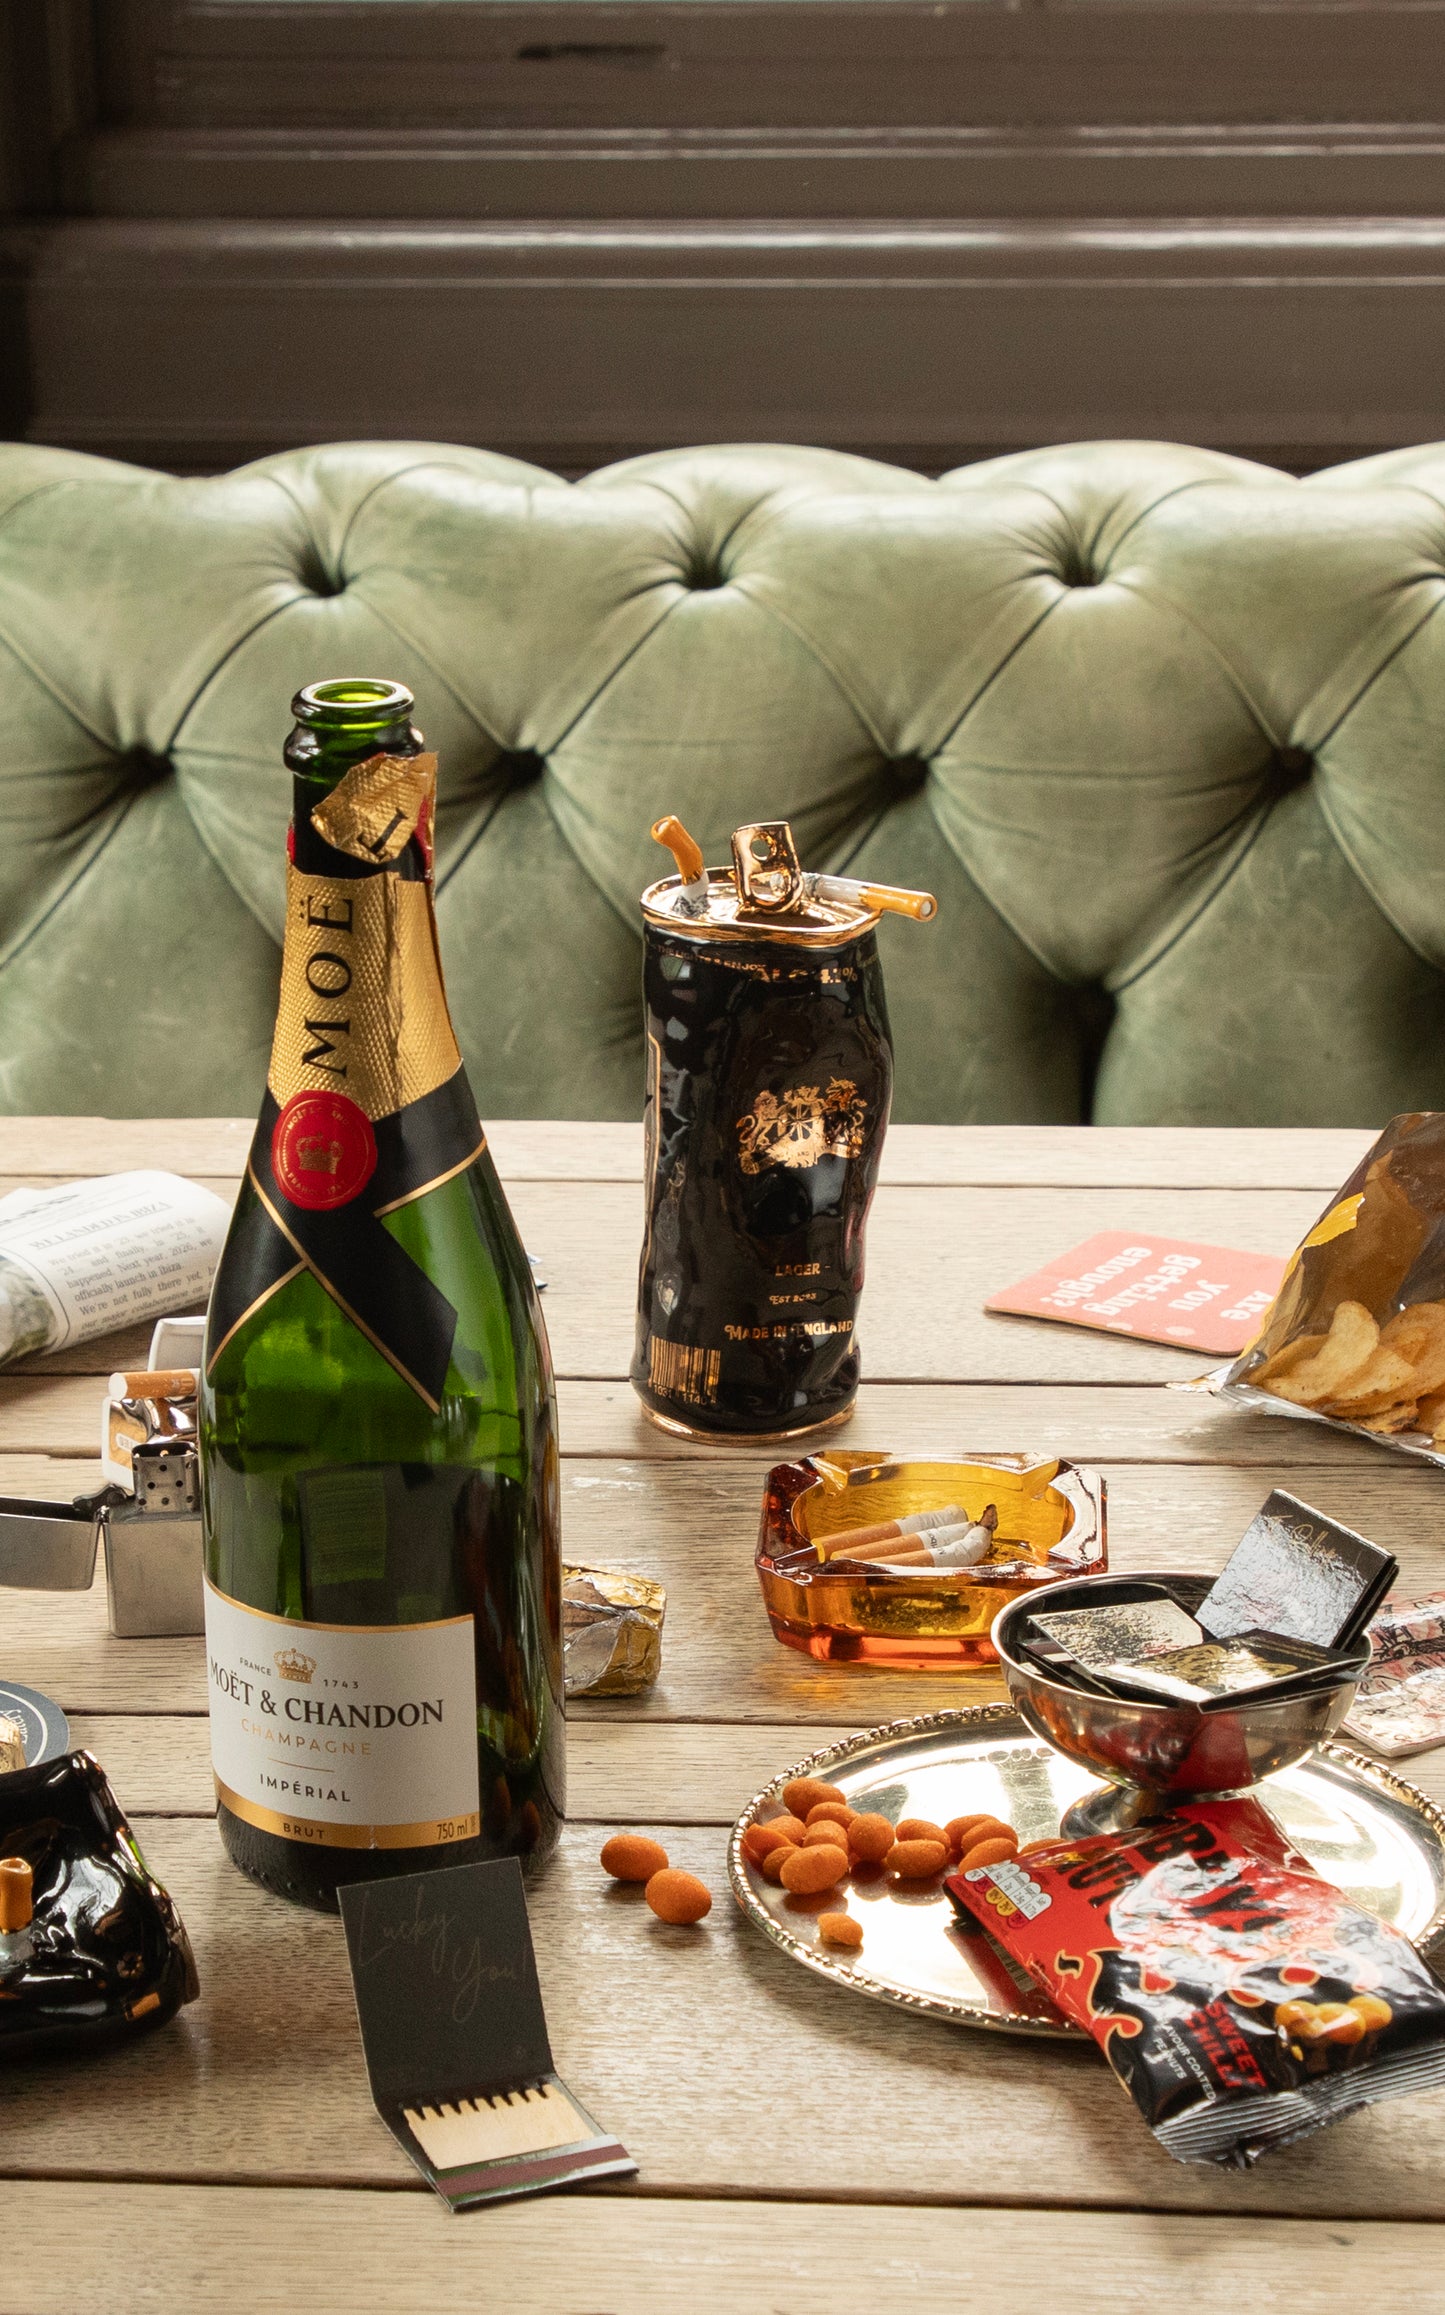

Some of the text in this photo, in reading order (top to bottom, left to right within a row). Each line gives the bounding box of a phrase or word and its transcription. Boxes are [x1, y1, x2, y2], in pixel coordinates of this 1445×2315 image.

[775, 1262, 821, 1277] LAGER
[1040, 1246, 1153, 1308] enough?
[1081, 1254, 1203, 1317] getting
[74, 1283, 113, 1303] officially
[114, 1273, 146, 1290] launch
[79, 1302, 108, 1317] We're
[113, 1294, 129, 1305] not
[133, 1285, 153, 1300] fully
[157, 1278, 182, 1292] there
[769, 1294, 791, 1306] EST
[1168, 1279, 1230, 1311] you
[1219, 1290, 1275, 1321] Are
[724, 1320, 853, 1341] MADE IN ENGLAND
[239, 1655, 360, 1690] FRANCE 1743
[209, 1654, 444, 1730] MOËT & CHANDON
[241, 1717, 372, 1757] CHAMPAGNE
[260, 1772, 352, 1803] IMPÉRIAL
[282, 1821, 325, 1840] BRUT
[436, 1822, 455, 1840] 750
[457, 1818, 468, 1836] ml
[1152, 2037, 1188, 2079] PEANUTS
[1158, 2016, 1217, 2101] LAVOUR COATED
[1184, 2010, 1243, 2088] CHILLI
[1204, 2000, 1267, 2088] SWEET
